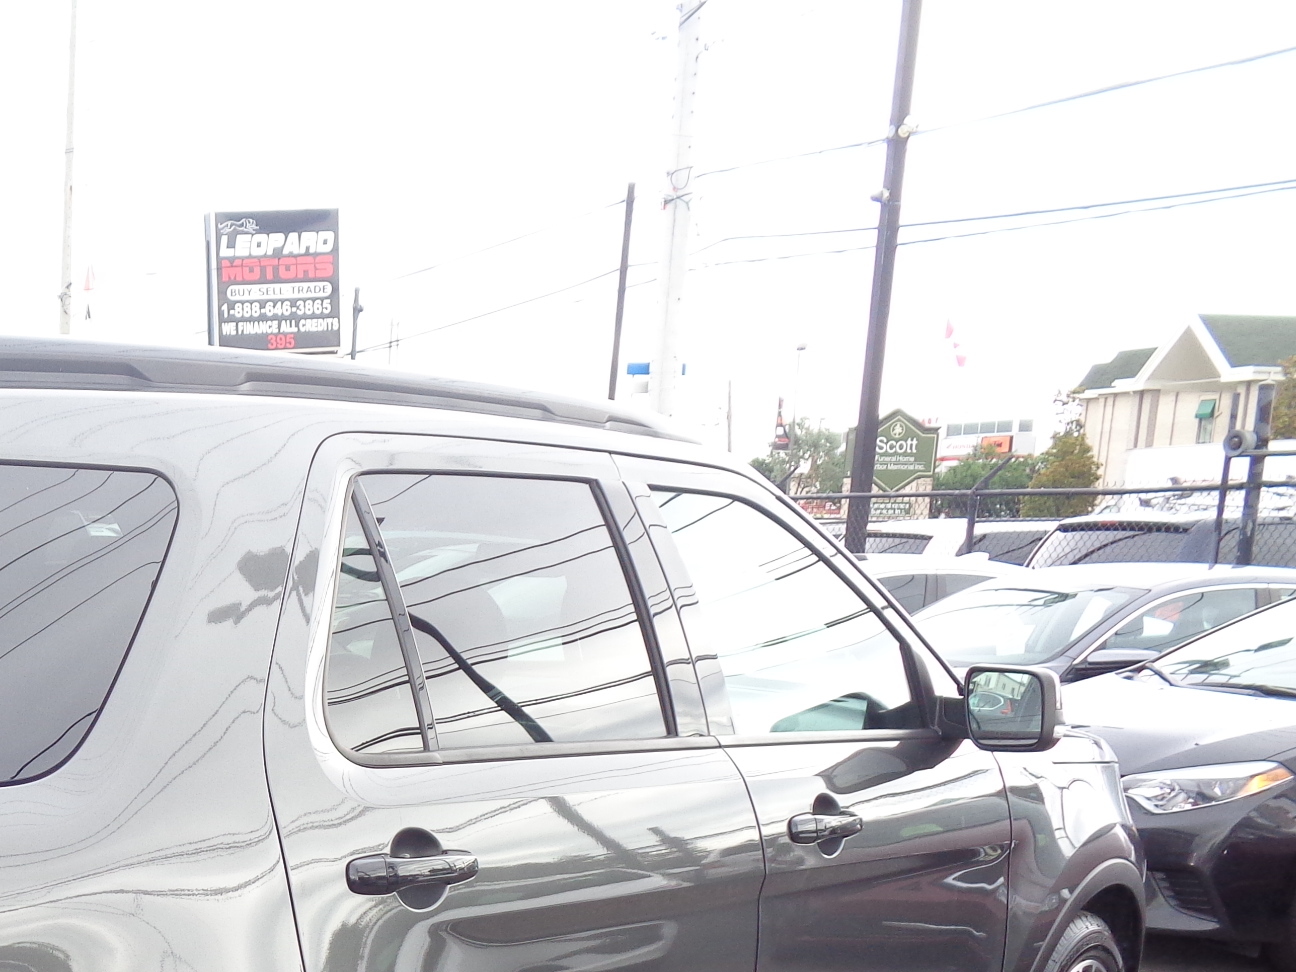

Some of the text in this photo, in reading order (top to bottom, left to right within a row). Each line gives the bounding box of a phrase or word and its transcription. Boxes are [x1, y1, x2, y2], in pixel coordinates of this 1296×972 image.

[219, 230, 335, 257] LEOPARD
[221, 255, 334, 282] MOTORS
[230, 284, 329, 297] BUY SELL TRADE
[220, 299, 332, 319] 1-888-646-3865
[221, 317, 340, 336] WE FINANCE ALL CREDITS
[267, 334, 295, 349] 395
[875, 436, 918, 453] Scott
[875, 454, 915, 462] Funeral Home
